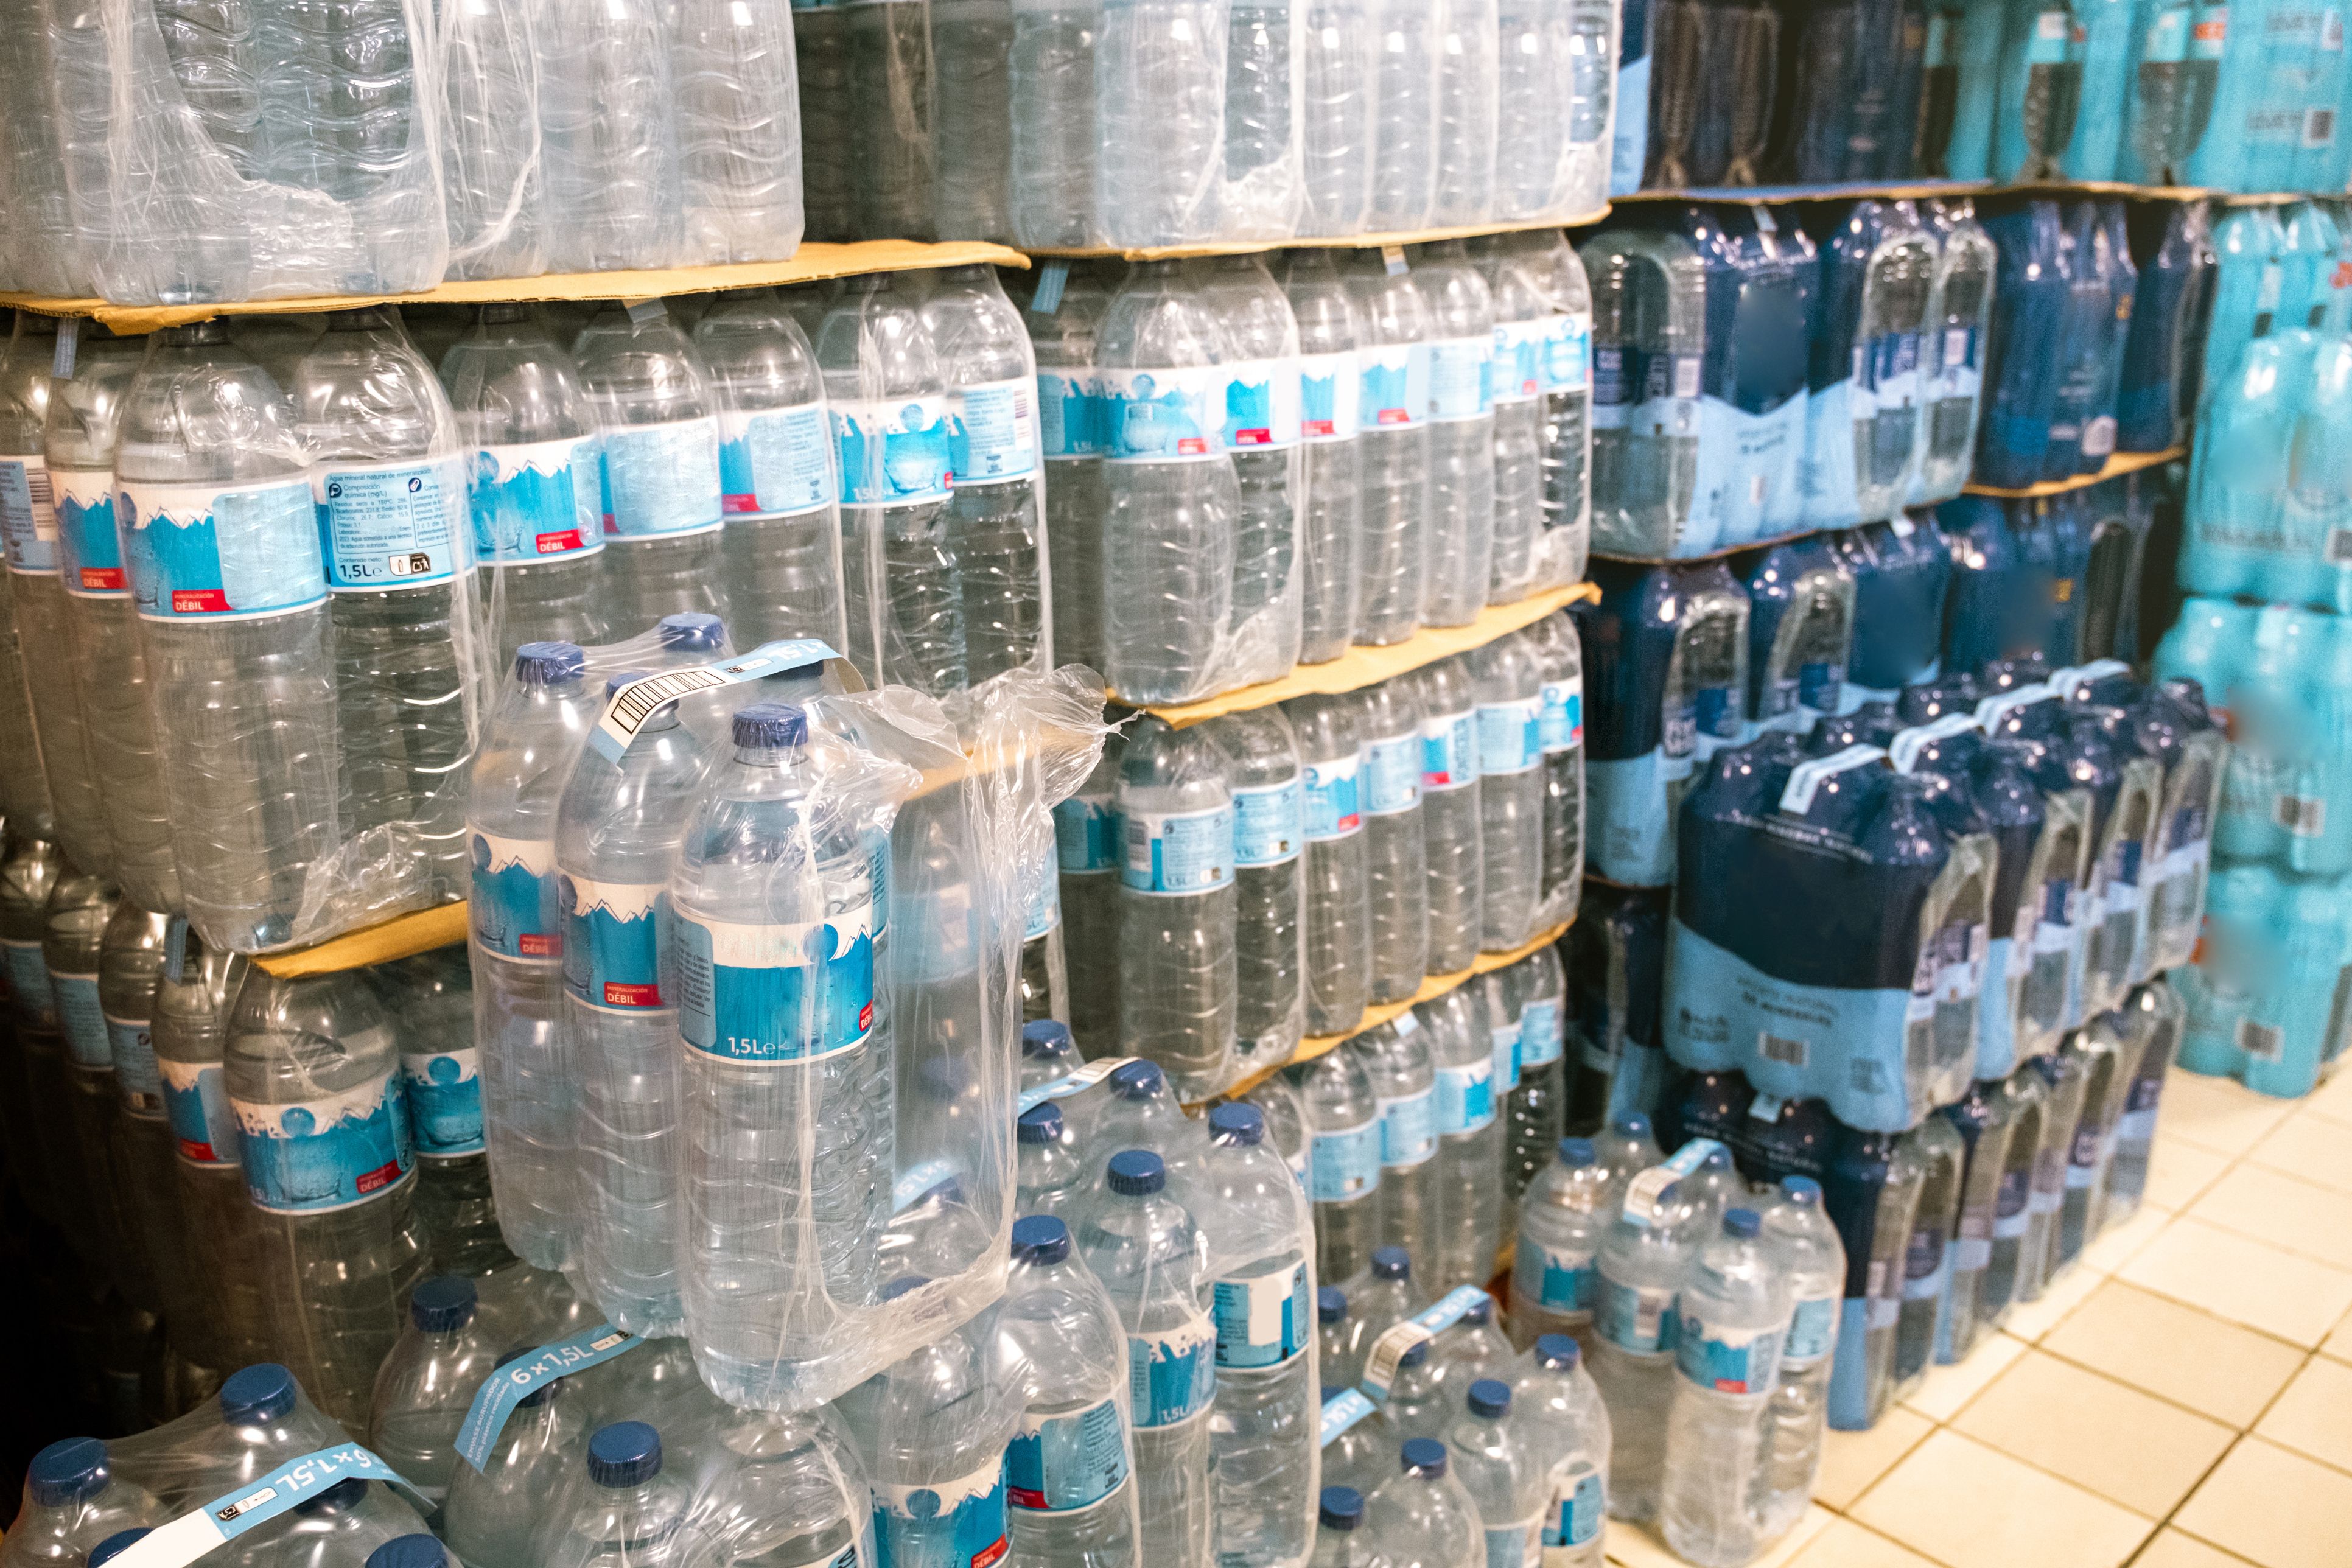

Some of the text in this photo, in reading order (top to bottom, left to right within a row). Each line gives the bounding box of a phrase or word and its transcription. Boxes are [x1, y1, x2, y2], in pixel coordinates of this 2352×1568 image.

[343, 484, 380, 492] Composición
[539, 541, 565, 552] DÉBIL
[175, 599, 204, 611] DÉBIL
[606, 985, 648, 993] MINERALIZACIÓN
[607, 992, 637, 1004] DÉBIL
[360, 1177, 387, 1192] DÉBIL
[510, 1345, 595, 1384] 6 x 1,5L
[467, 1377, 501, 1458] ENVASE AGRUPADOR
[275, 1449, 372, 1491] 6 x 1,5L
